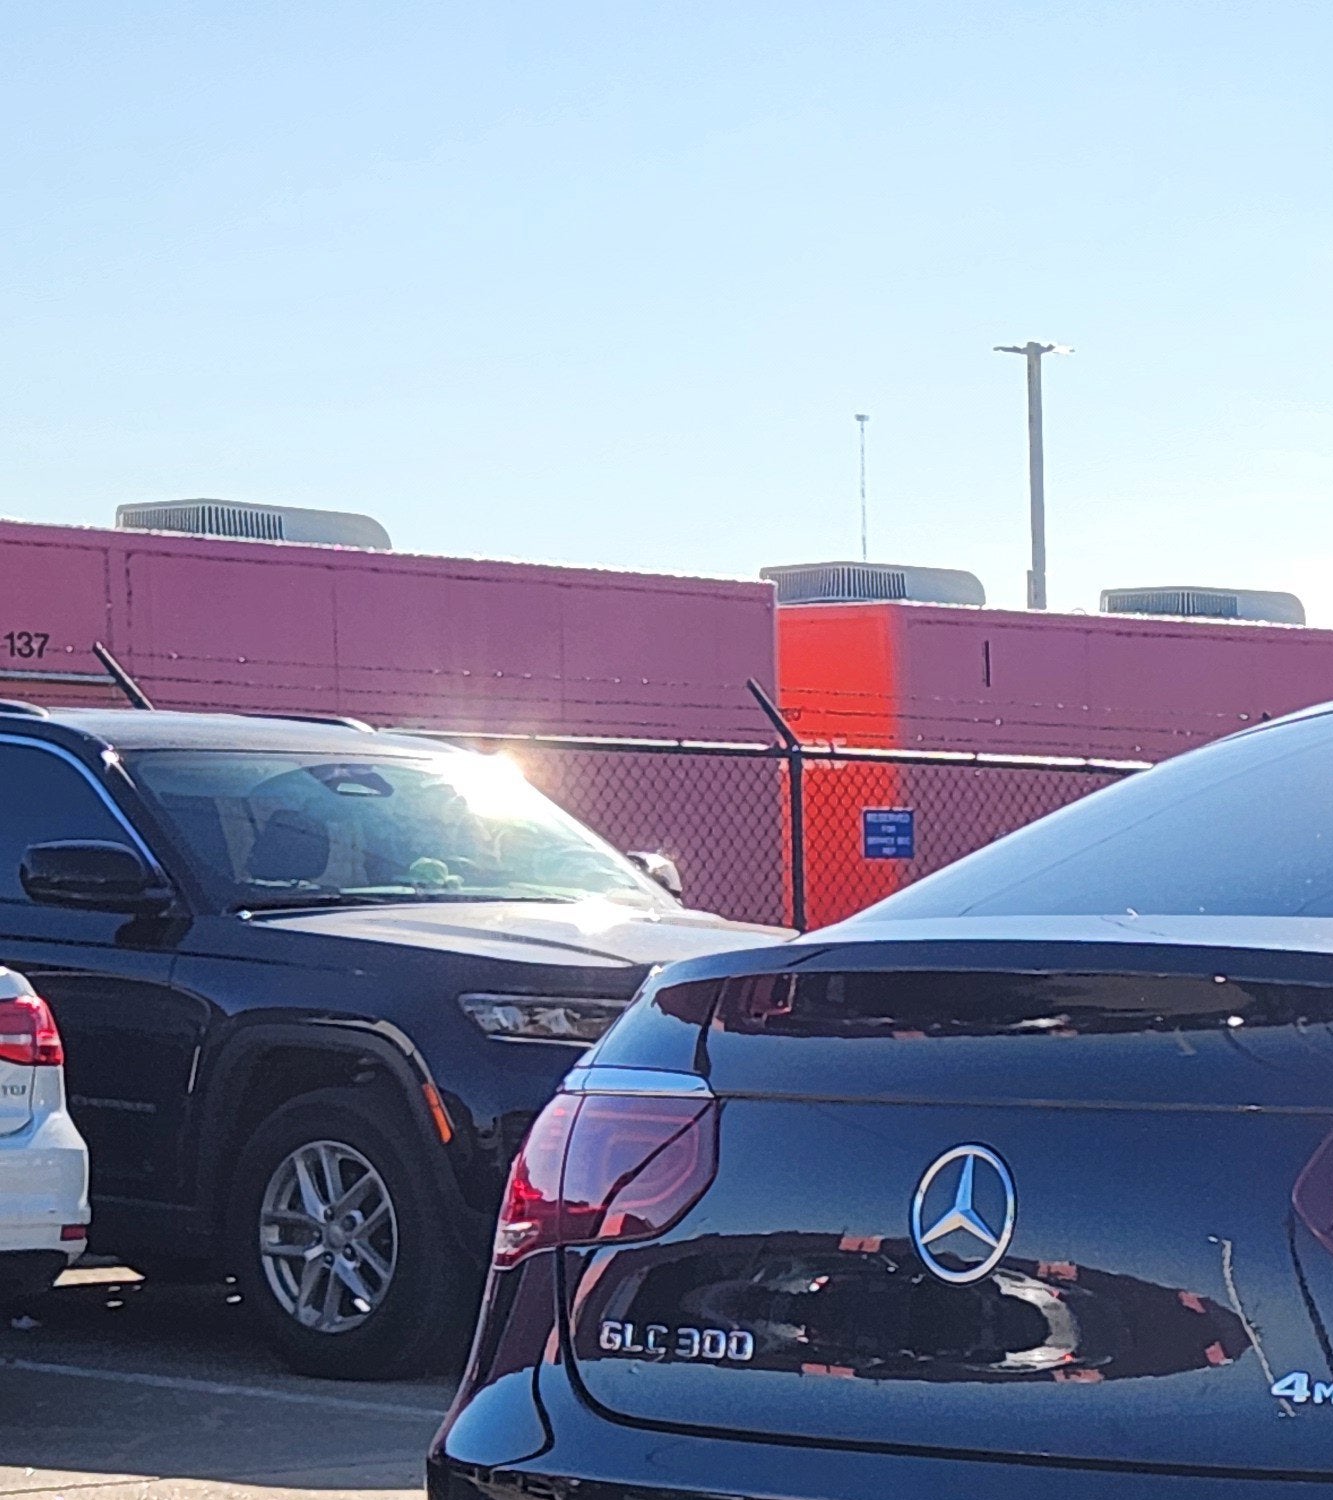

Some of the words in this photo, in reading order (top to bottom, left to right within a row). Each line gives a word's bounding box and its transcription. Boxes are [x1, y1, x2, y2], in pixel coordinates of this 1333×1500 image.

[3, 630, 50, 659] 137
[599, 1320, 669, 1355] GLC
[674, 1327, 754, 1361] 300
